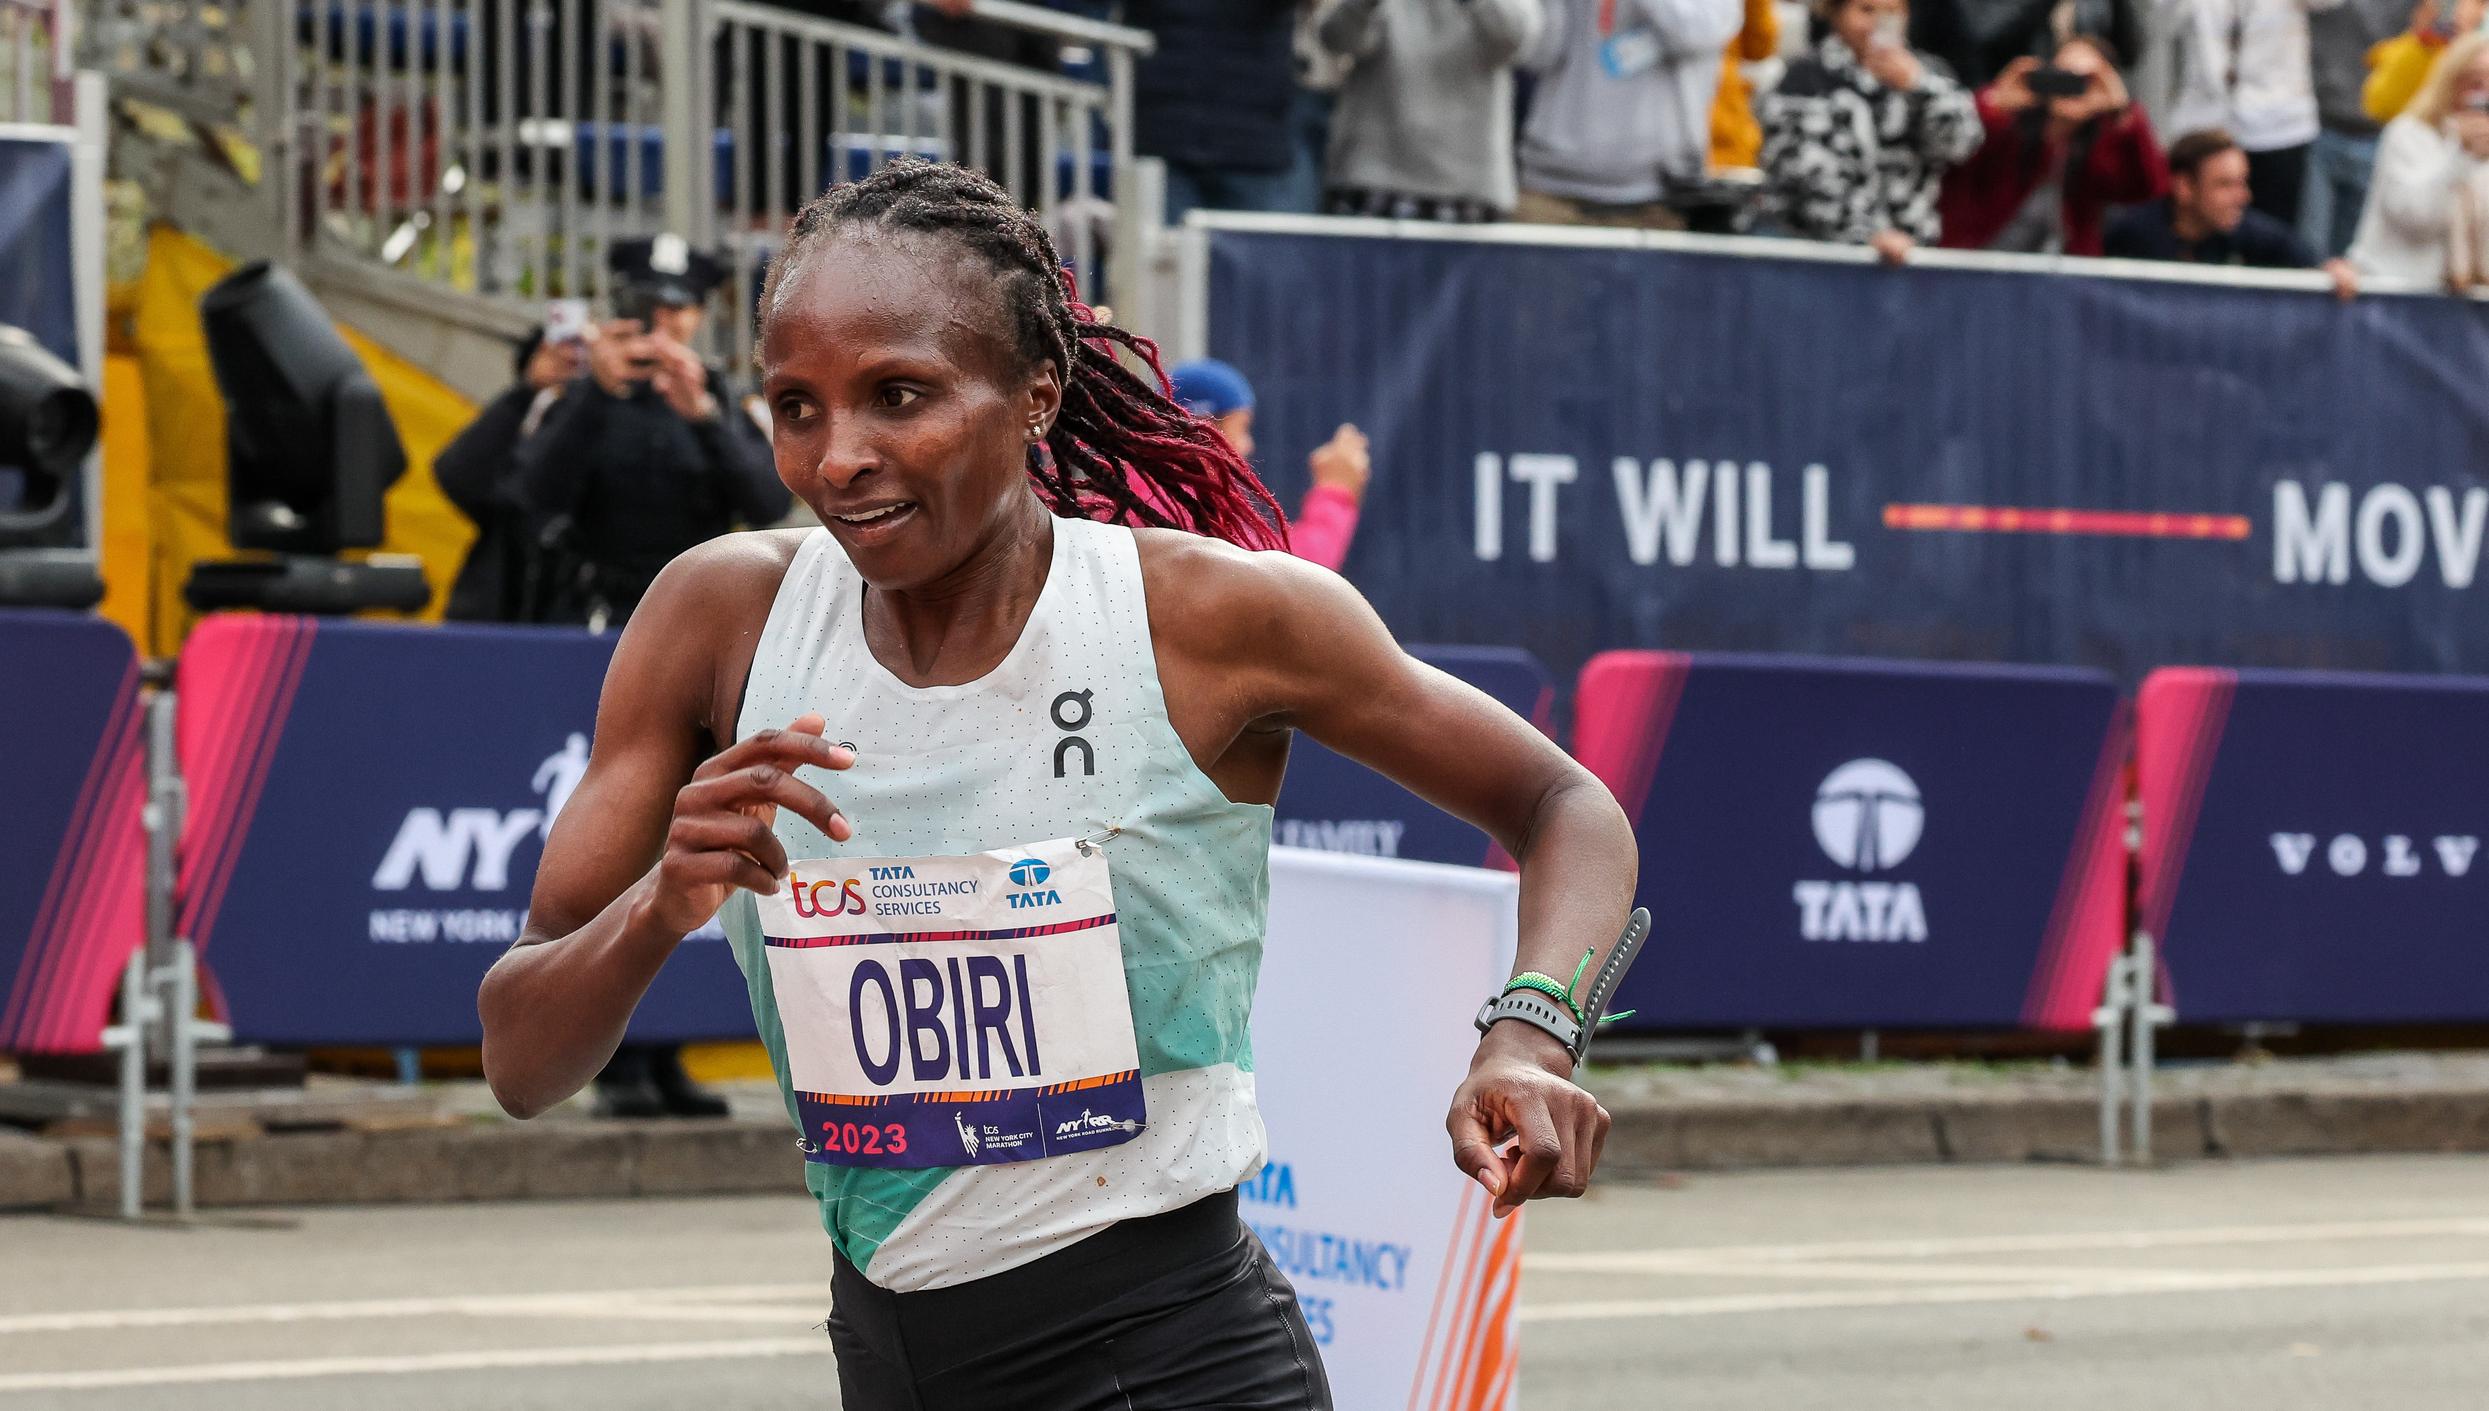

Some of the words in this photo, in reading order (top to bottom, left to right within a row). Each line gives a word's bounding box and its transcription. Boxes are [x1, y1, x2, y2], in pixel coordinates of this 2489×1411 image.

[1475, 452, 1577, 563] IT
[1612, 456, 1855, 570] WILL
[2273, 479, 2489, 589] MOV
[2269, 832, 2489, 877] VOLV
[869, 866, 915, 881] TATA
[872, 880, 978, 899] CONSULTANCY
[790, 871, 866, 918] tcs
[875, 901, 941, 916] SERVICES
[1006, 890, 1062, 909] TATA
[1793, 880, 1928, 942] TATA
[369, 908, 437, 943] NEW
[442, 908, 514, 943] YORK
[849, 954, 1041, 1086] OBIRI
[822, 1120, 907, 1155] 2023
[983, 1124, 999, 1135] tcs
[986, 1140, 1023, 1149] MARATHON
[1000, 1134, 1018, 1142] YORK
[1018, 1132, 1033, 1140] CITY
[1239, 1160, 1297, 1208] ATA
